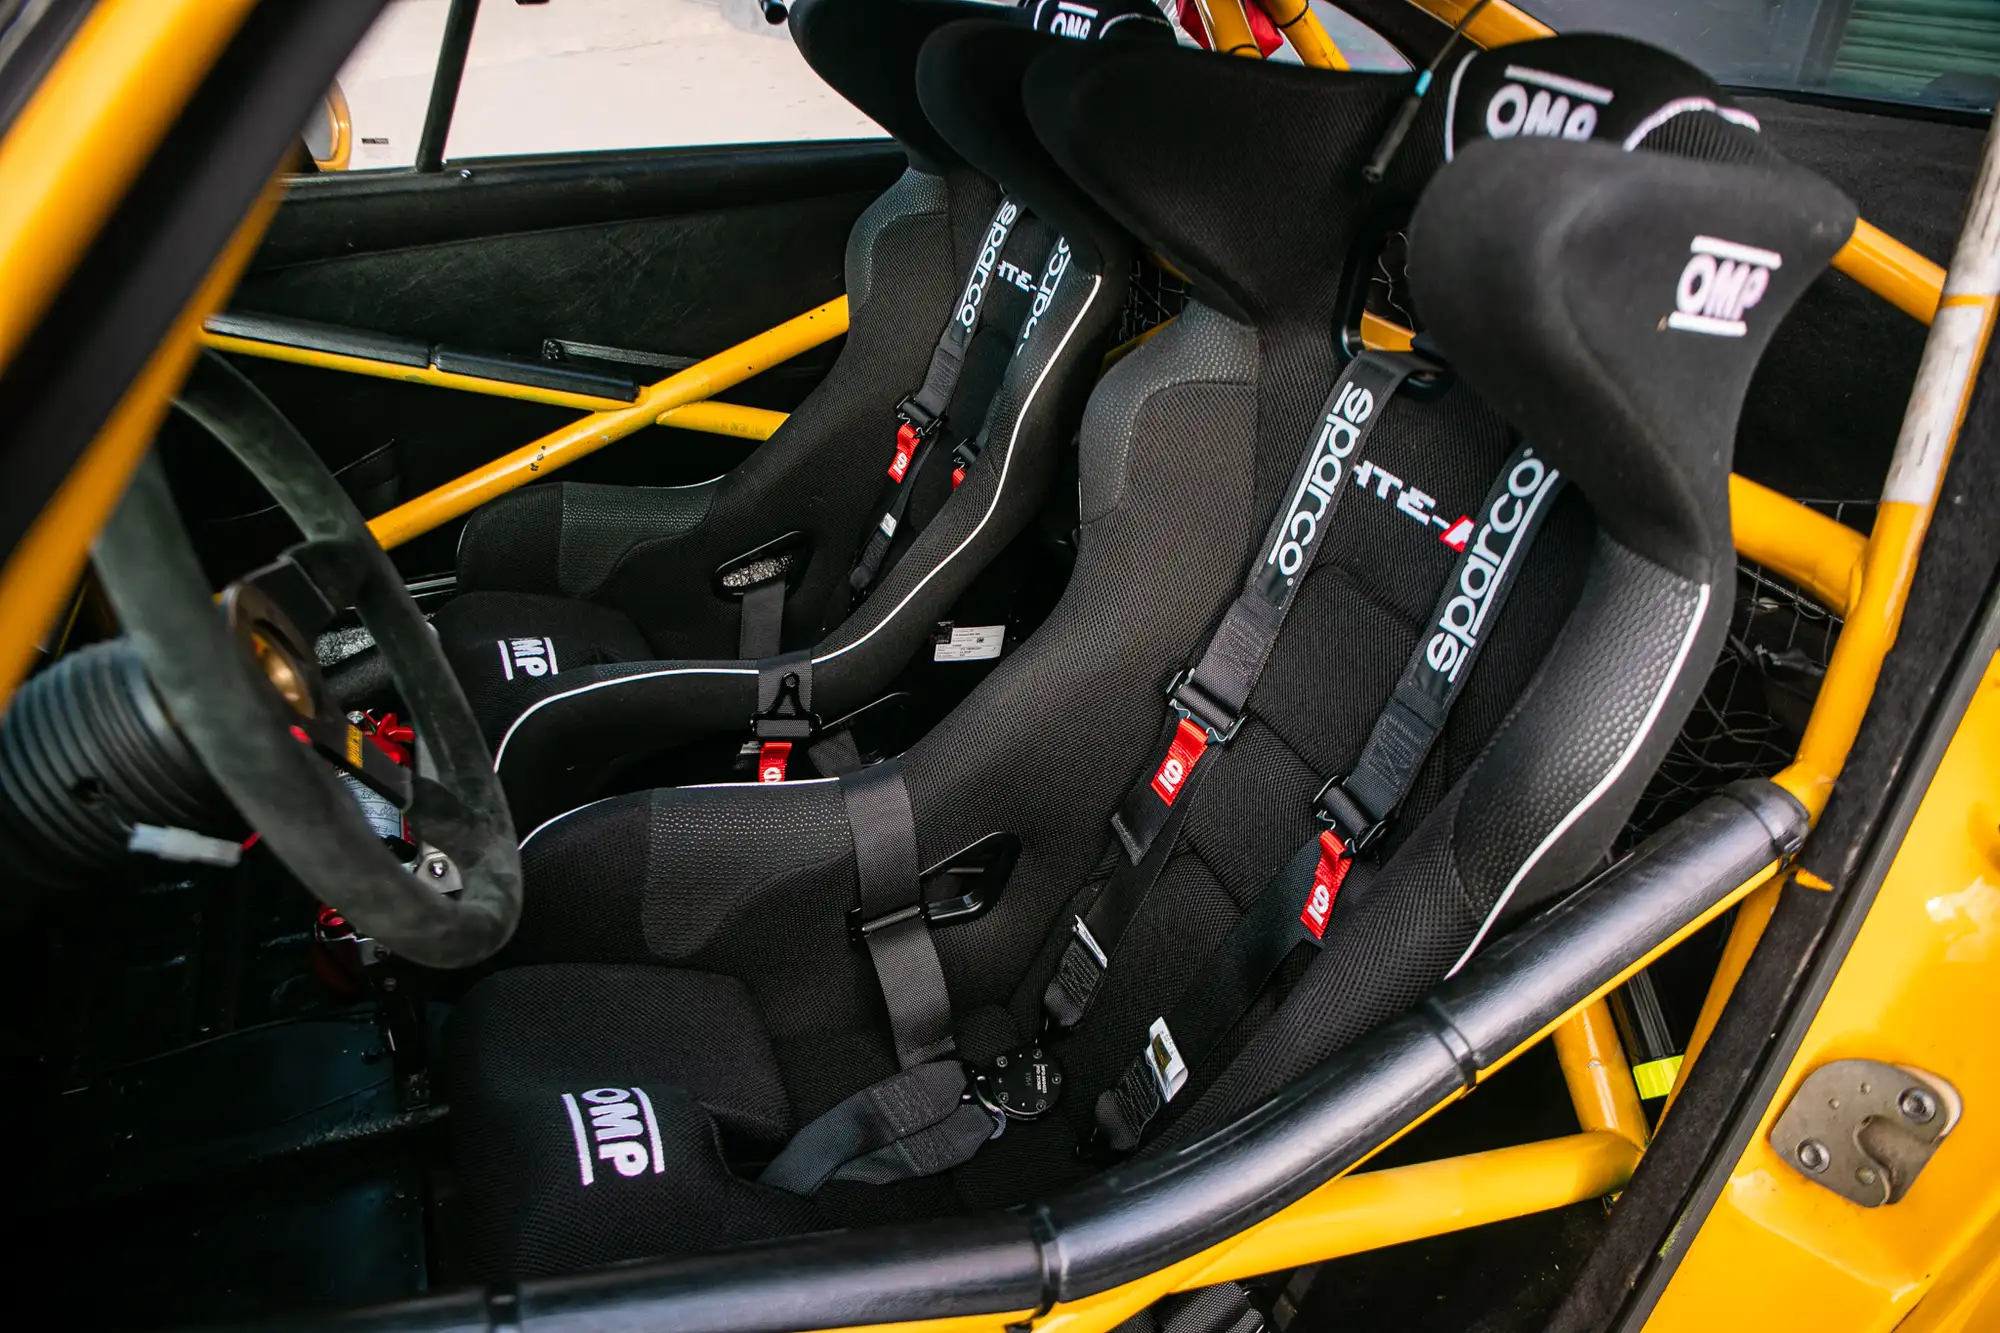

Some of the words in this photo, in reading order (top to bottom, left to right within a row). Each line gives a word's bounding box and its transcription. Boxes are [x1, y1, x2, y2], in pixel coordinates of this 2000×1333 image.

[1486, 84, 1598, 142] OMP
[958, 201, 1017, 332] sparco
[1676, 253, 1770, 322] OMP
[1269, 382, 1374, 577] sparco
[1426, 456, 1559, 682] sparco
[510, 637, 548, 676] MP
[581, 1088, 649, 1177] OMP
